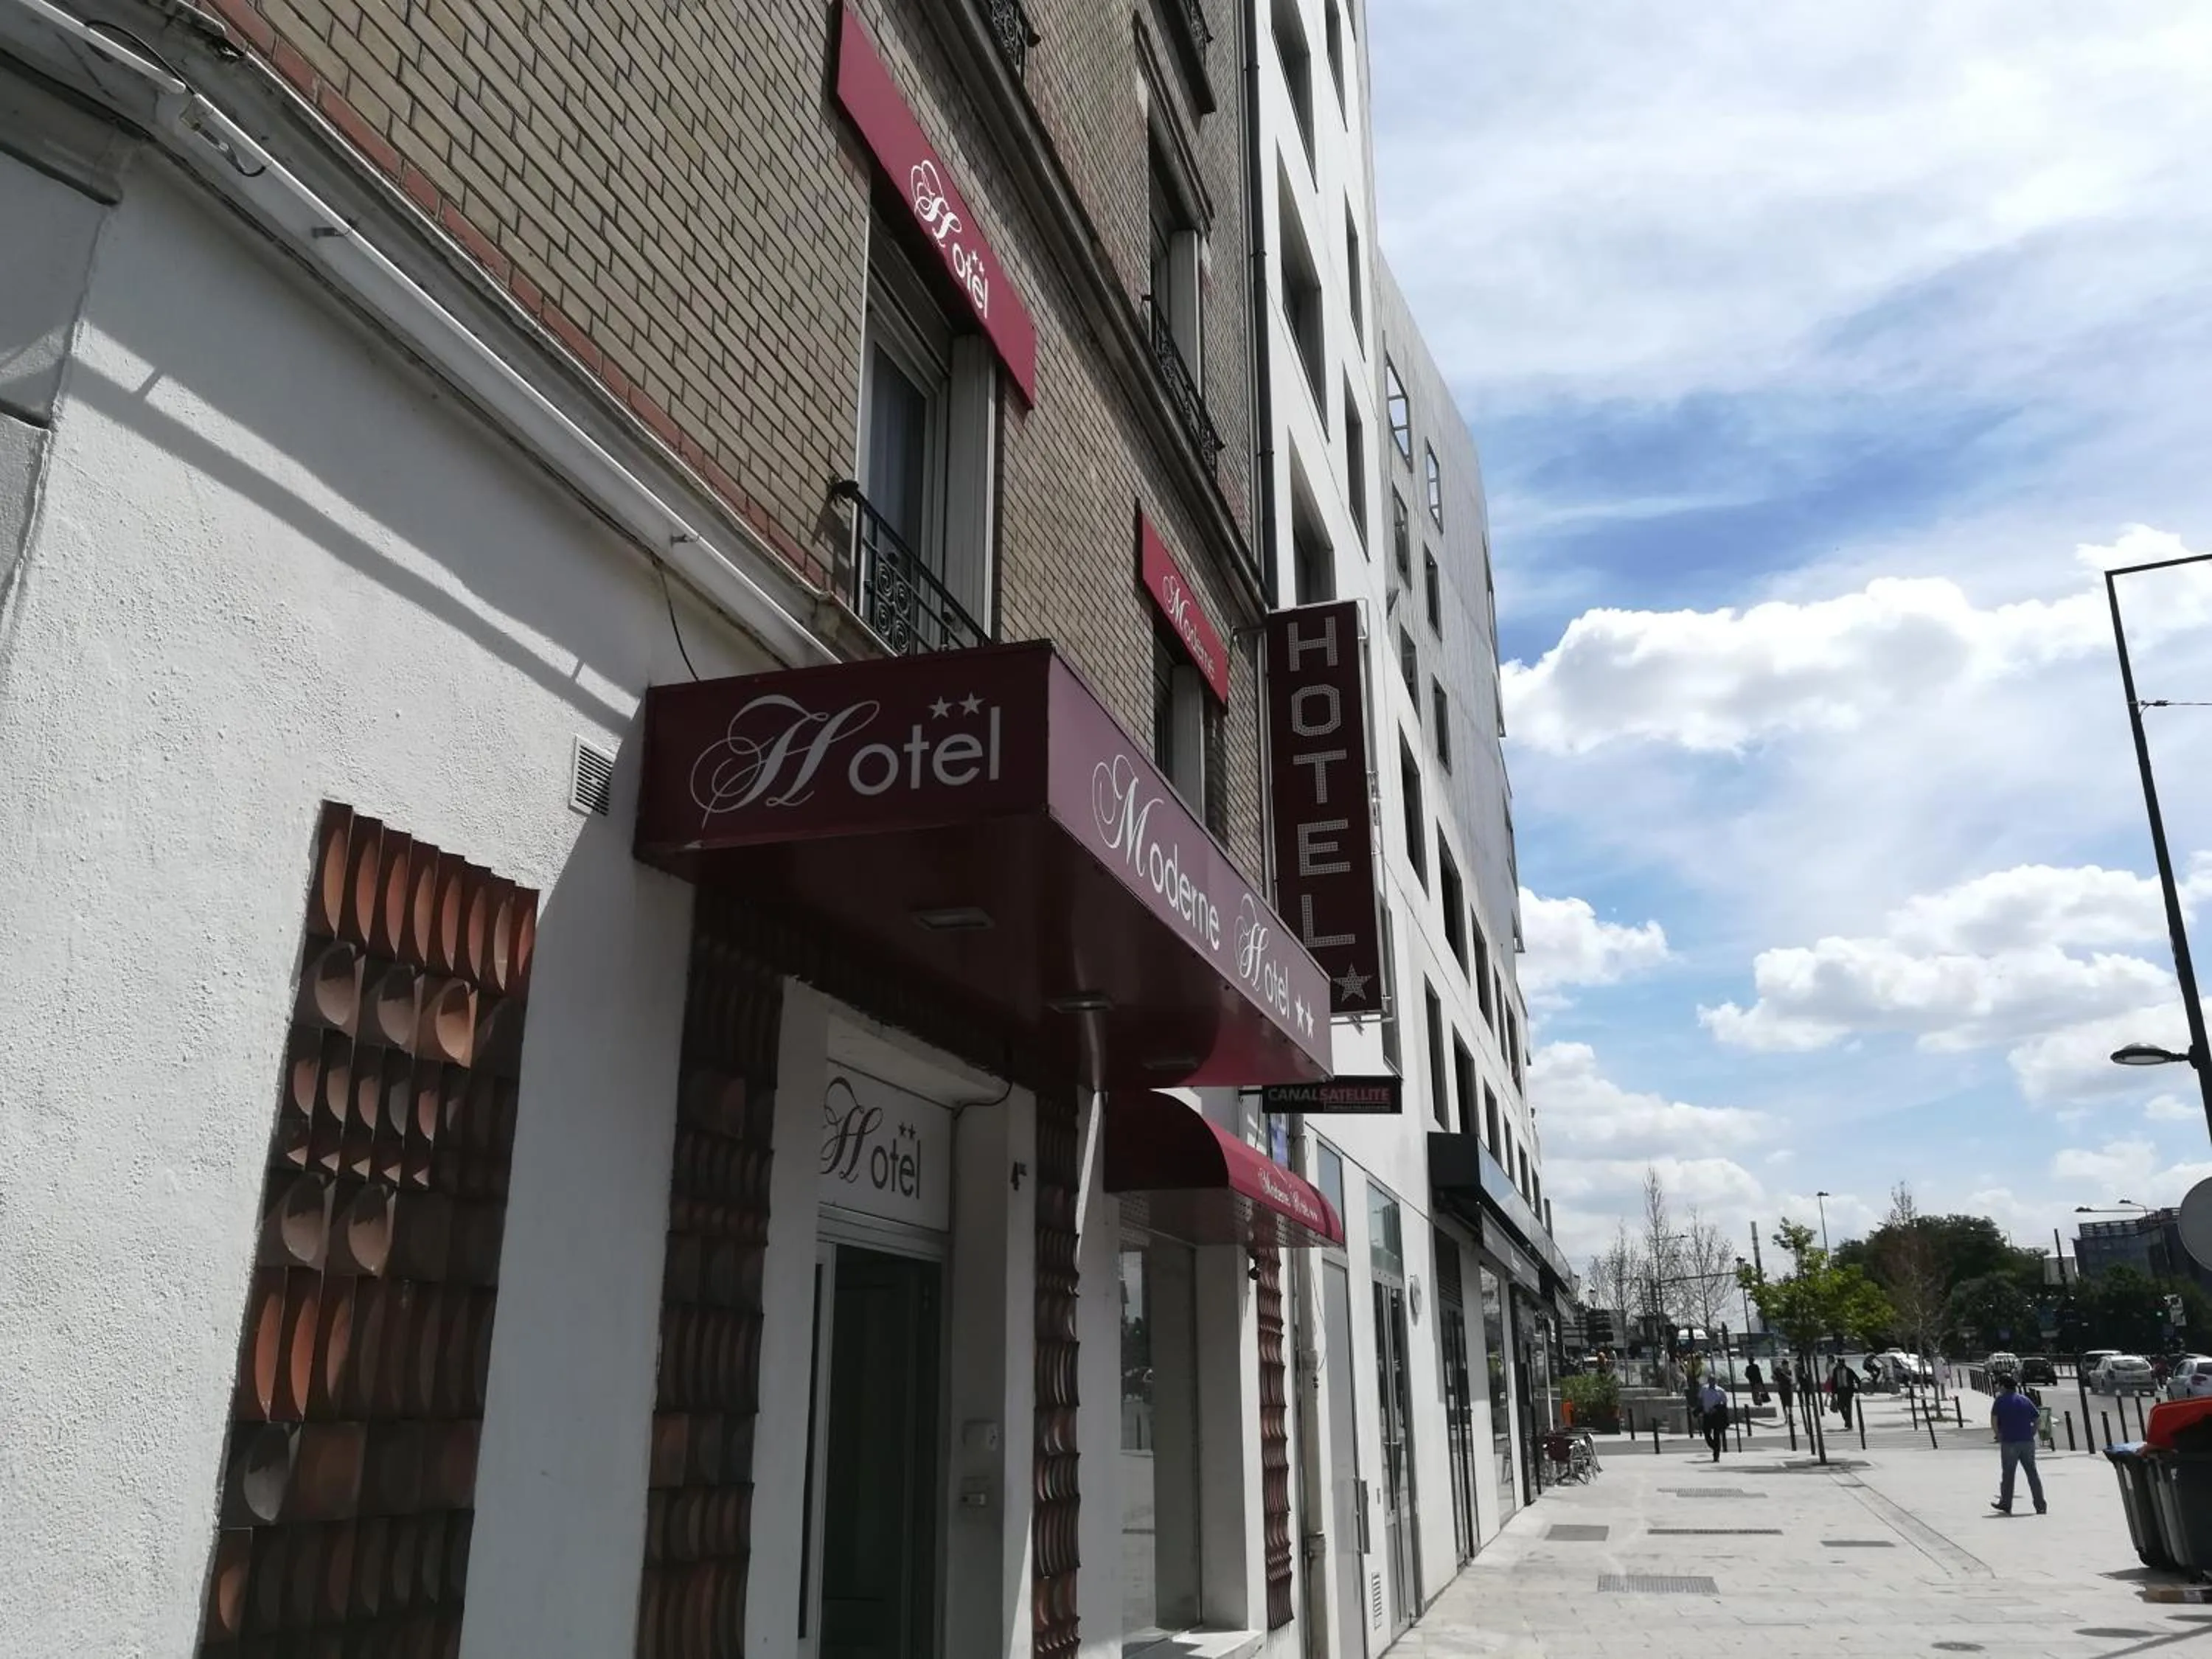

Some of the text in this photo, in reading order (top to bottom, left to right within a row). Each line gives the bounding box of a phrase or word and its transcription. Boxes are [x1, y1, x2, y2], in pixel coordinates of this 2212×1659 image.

[910, 159, 989, 319] Hotel
[689, 694, 1001, 830] Hotel
[1287, 616, 1356, 950] HOTEL
[1091, 754, 1290, 1020] Moderne Hotel
[818, 1076, 921, 1200] Hotel
